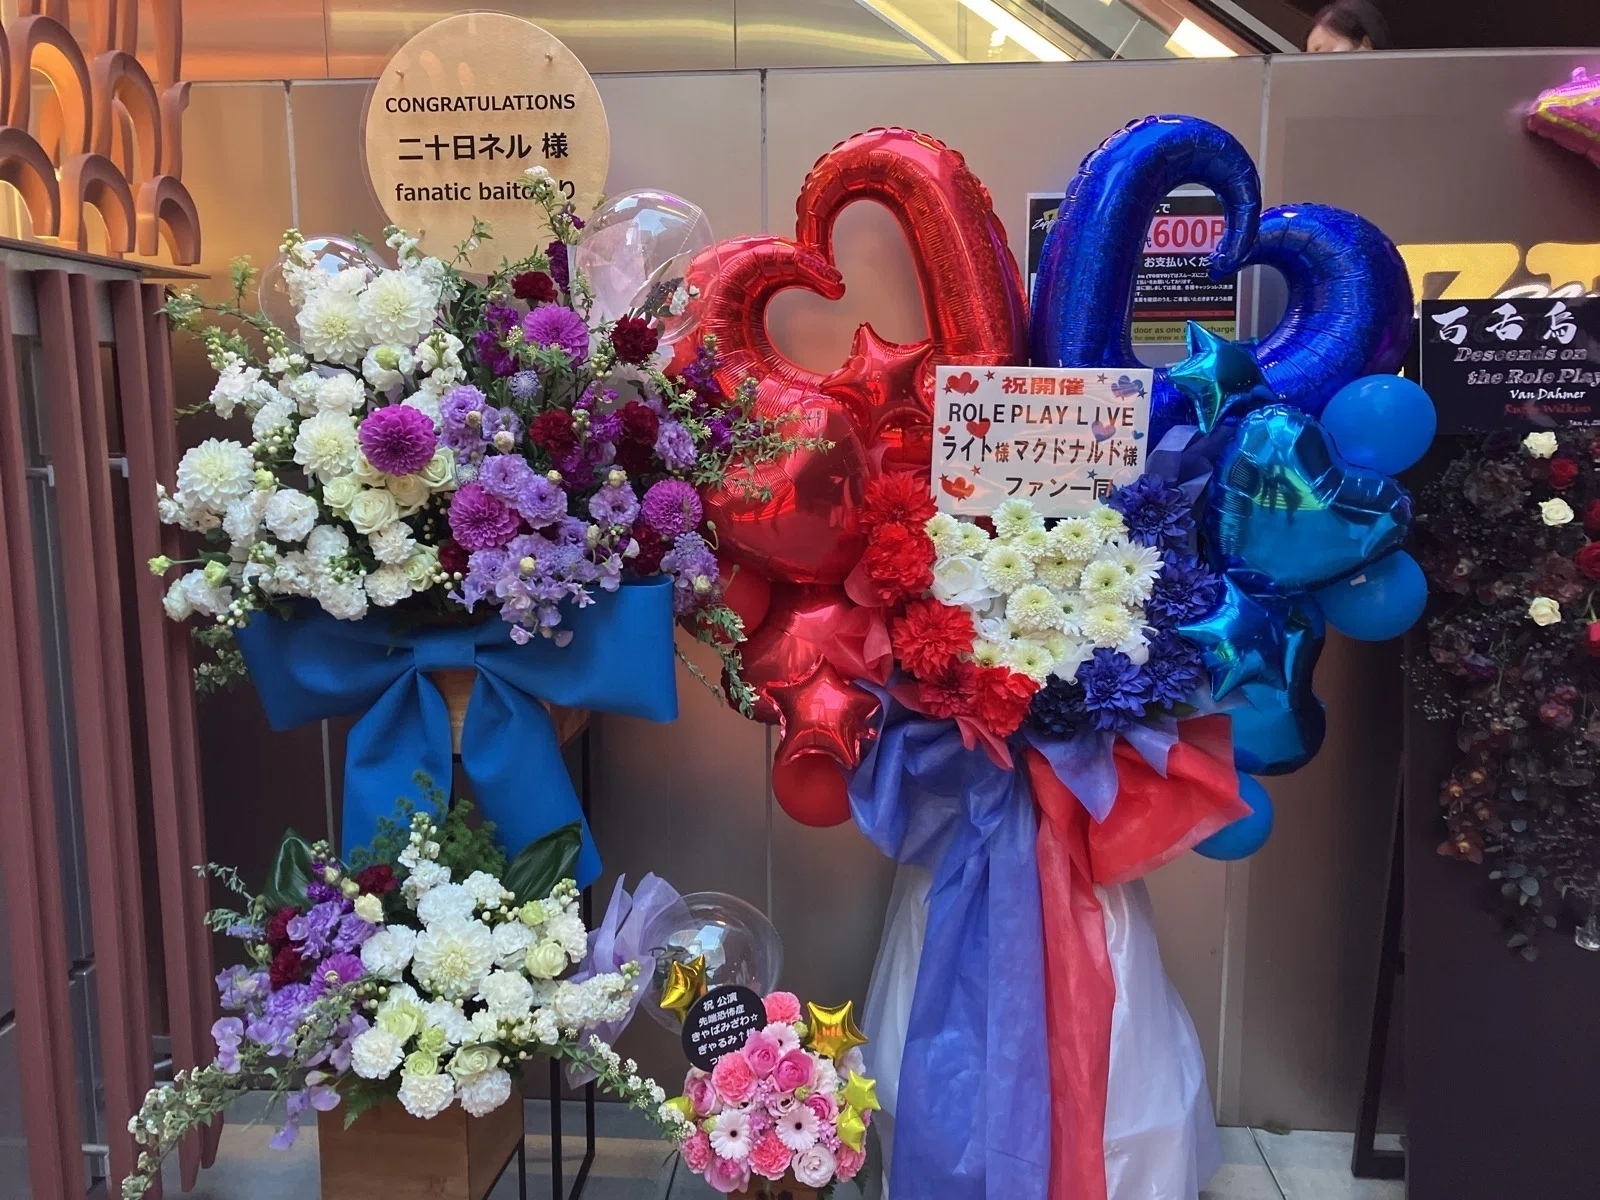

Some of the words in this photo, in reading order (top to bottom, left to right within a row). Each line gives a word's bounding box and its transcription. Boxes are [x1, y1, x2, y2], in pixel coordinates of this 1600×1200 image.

[385, 94, 575, 113] CONGRATULATIONS
[398, 133, 532, 160] 二十日ネル
[542, 132, 569, 159] 様
[396, 182, 471, 201] fanatic
[1453, 346, 1557, 362] Descends
[1560, 348, 1588, 361] on
[1001, 376, 1085, 396] 祝開催
[1467, 369, 1503, 385] the
[1505, 368, 1555, 384] Role
[1510, 389, 1535, 399] Van
[1537, 387, 1586, 400] Dahmer
[949, 403, 1005, 423] ROLE
[1011, 404, 1068, 424] PLAY
[1077, 406, 1135, 427] LIVE
